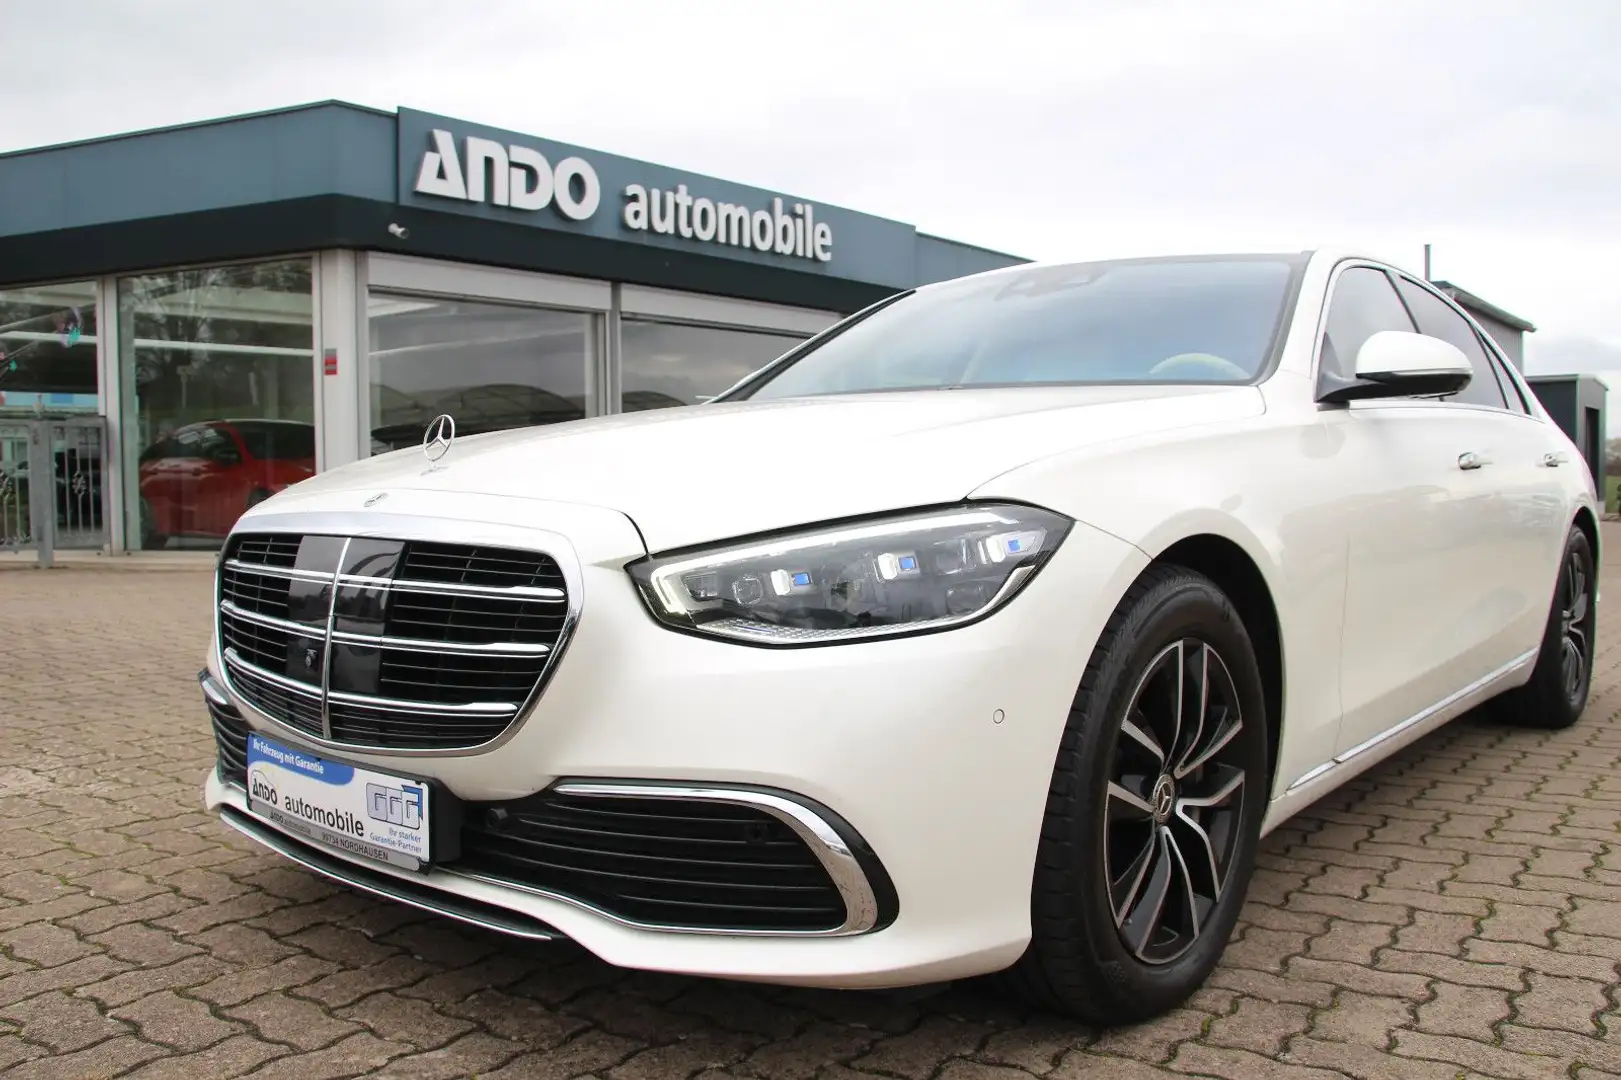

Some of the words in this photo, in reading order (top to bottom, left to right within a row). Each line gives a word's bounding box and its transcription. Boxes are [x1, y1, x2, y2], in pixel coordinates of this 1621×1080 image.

[414, 128, 601, 221] ANDO
[623, 183, 833, 262] automobile
[253, 738, 261, 750] Ihr
[260, 741, 284, 763] Fahrzeug
[284, 753, 295, 765] mit
[295, 755, 324, 775] Garantie
[252, 778, 278, 805] ANDO
[285, 795, 364, 837] automobile
[340, 836, 389, 861] NORDHAUSEN
[388, 827, 398, 837] Ihr
[398, 831, 422, 844] starker
